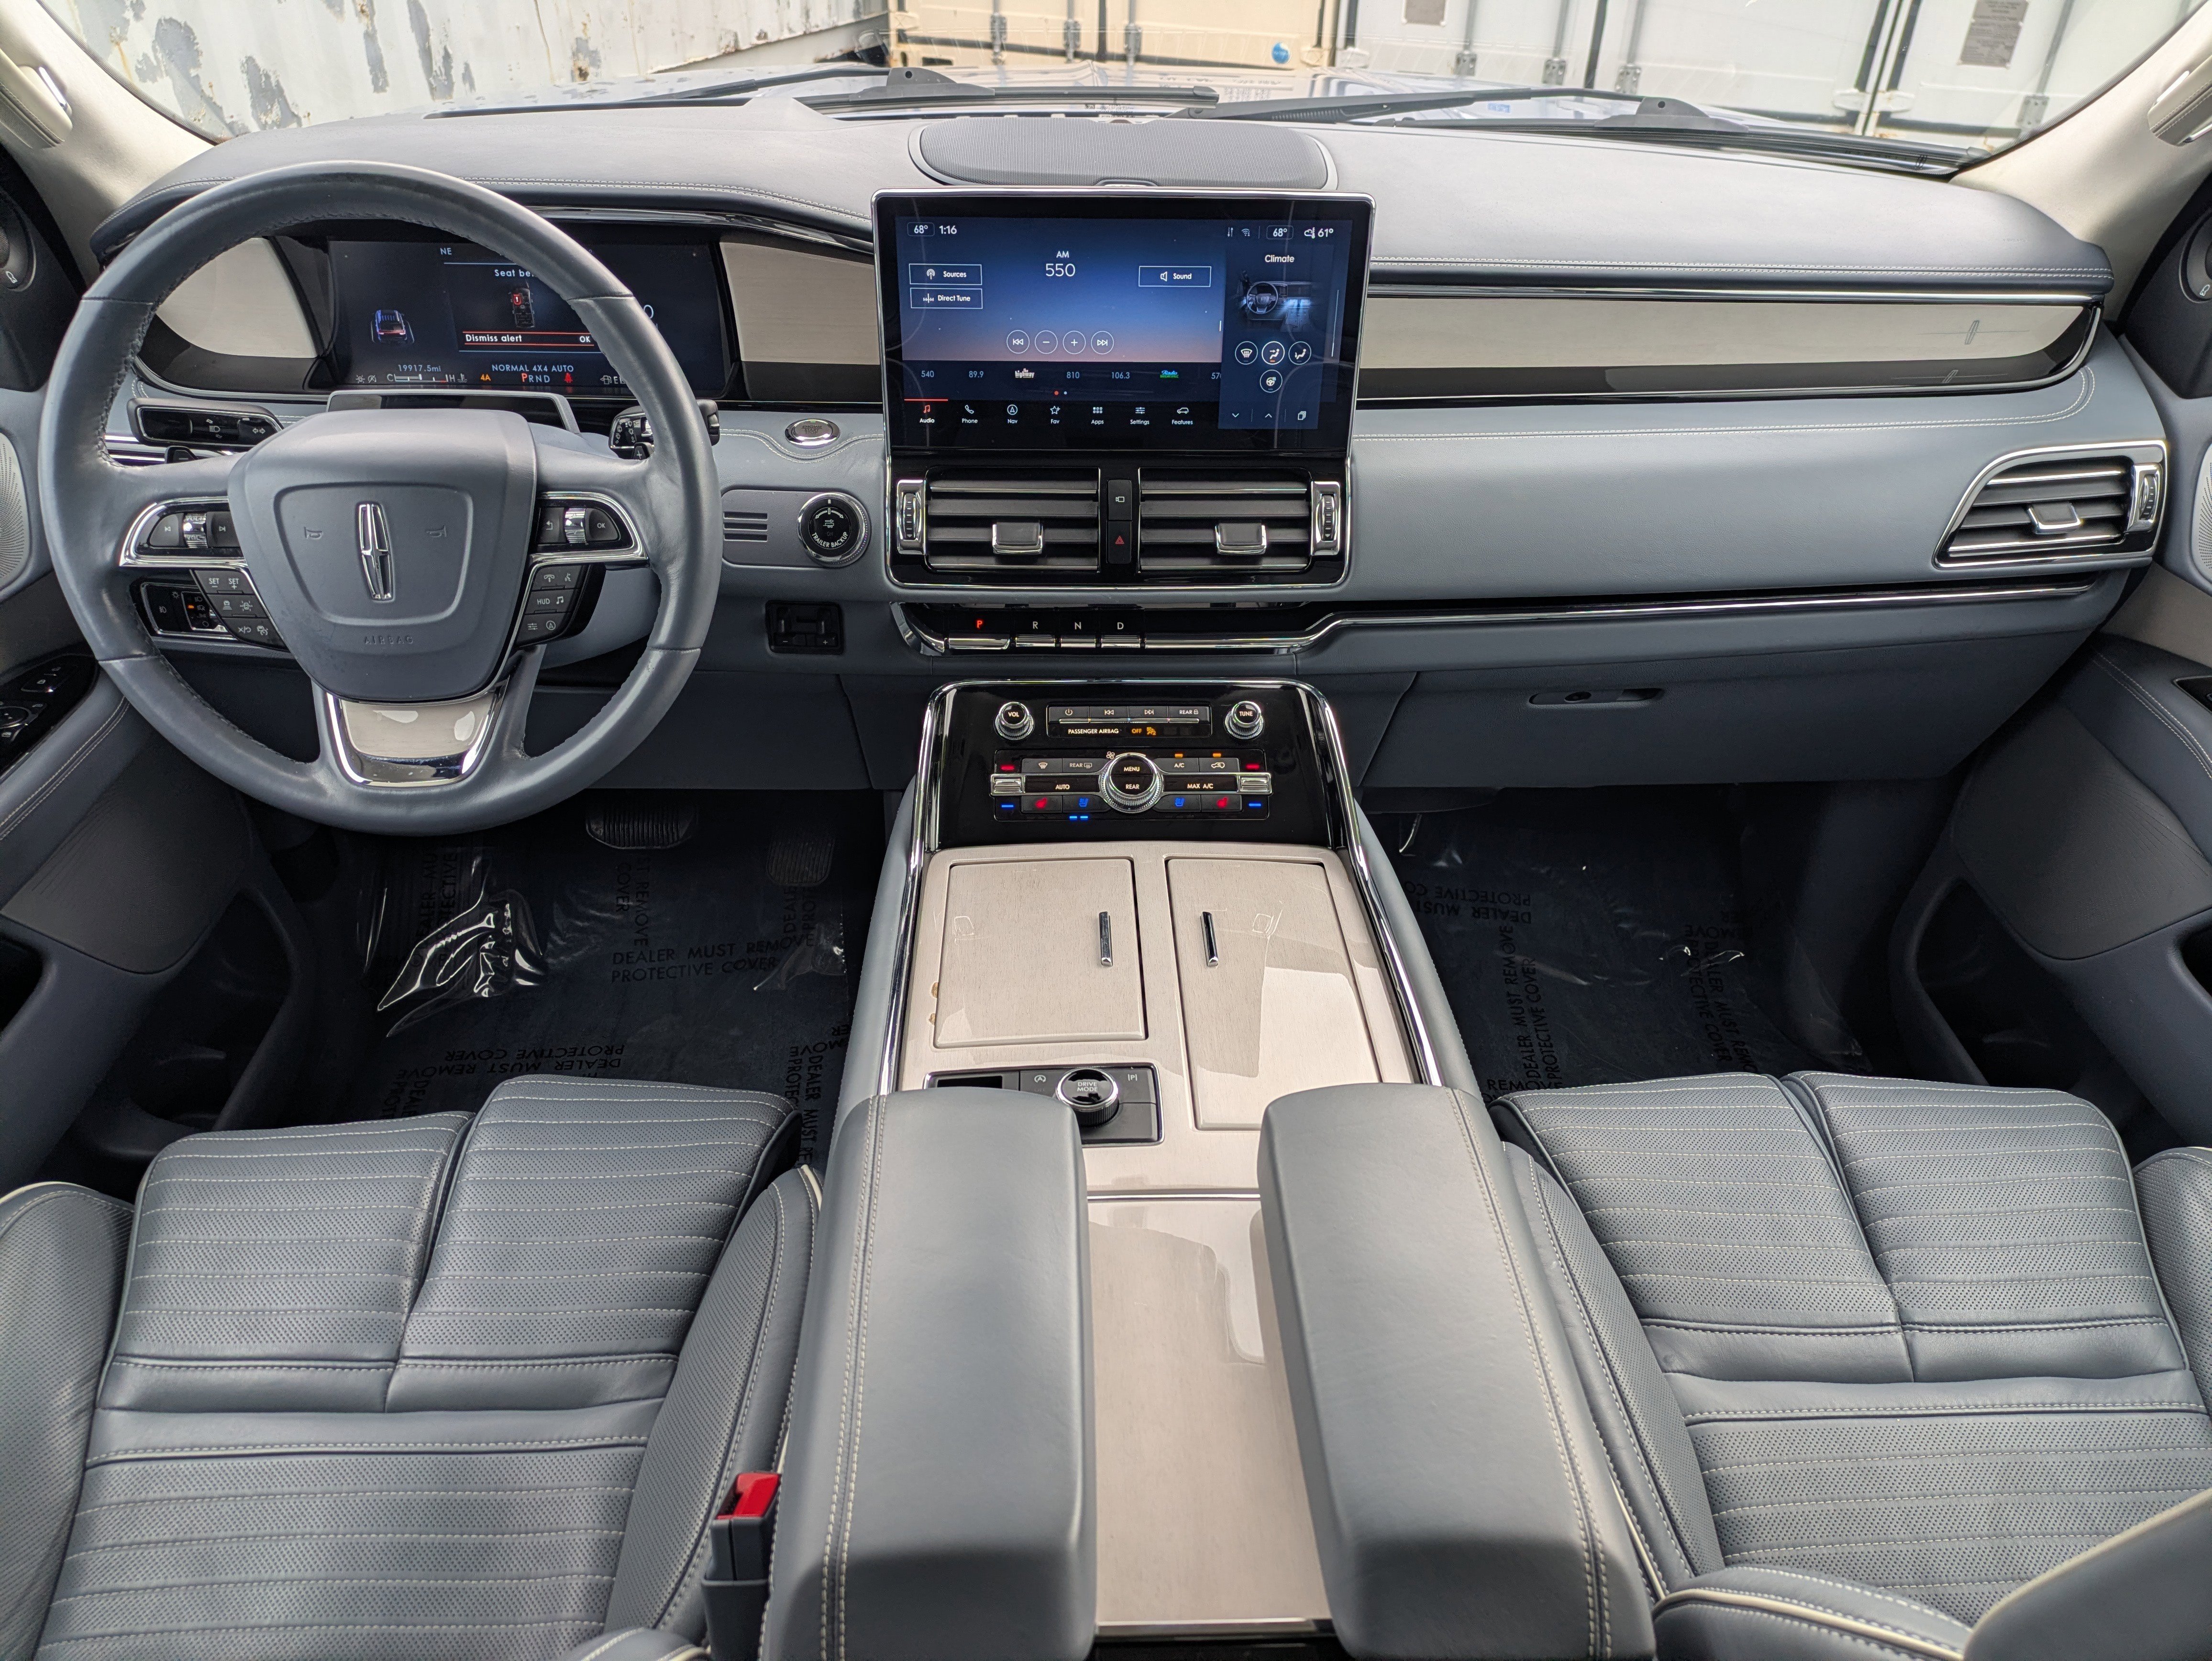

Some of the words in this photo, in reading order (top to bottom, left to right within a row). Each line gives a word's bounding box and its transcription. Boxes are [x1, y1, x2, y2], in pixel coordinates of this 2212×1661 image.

[914, 225, 928, 234] 68°
[939, 225, 957, 234] 1:16
[1272, 228, 1287, 237] 68°
[1317, 228, 1334, 237] 61°
[440, 247, 452, 255] NE
[1264, 255, 1294, 263] Climate
[1045, 263, 1075, 277] 550
[465, 334, 498, 342] Dismiss
[501, 334, 522, 342] alert
[387, 374, 393, 382] C
[449, 375, 455, 383] H
[1015, 370, 1035, 378] highway
[812, 532, 830, 548] TRAILER
[830, 532, 848, 548] BACKUP
[977, 620, 983, 629] P
[1032, 621, 1039, 630] R
[1074, 621, 1082, 630] N
[1117, 621, 1124, 630] D
[365, 635, 413, 645] AIRBAG
[616, 862, 632, 913] COVER
[1435, 886, 1531, 907] PROTECTIVE
[634, 881, 651, 947] REMOVE
[1416, 901, 1461, 916] MUST
[1471, 906, 1531, 924] DEALER
[613, 948, 675, 965] DEALER
[687, 942, 736, 959] MUST
[746, 933, 814, 954] REMOVE
[1499, 925, 1518, 986] REMOVE
[611, 963, 714, 983] PROTECTIVE
[721, 956, 779, 974] COVER
[1520, 957, 1542, 1004] COVER
[1505, 991, 1528, 1028] MUST
[1714, 1000, 1740, 1035] MUST
[1530, 1007, 1563, 1080] PROTECTIVE
[1704, 1023, 1733, 1062] COVER
[445, 1049, 508, 1062] COVER
[516, 1044, 625, 1060] PROTECTIVE
[1516, 1035, 1542, 1080] DEALER
[396, 1063, 477, 1080] REMOVE
[486, 1062, 542, 1074] MUST
[554, 1057, 622, 1071] DEALER
[784, 1058, 803, 1109] PROTEC
[805, 1054, 824, 1102] DEALER
[801, 1108, 819, 1143] MUST
